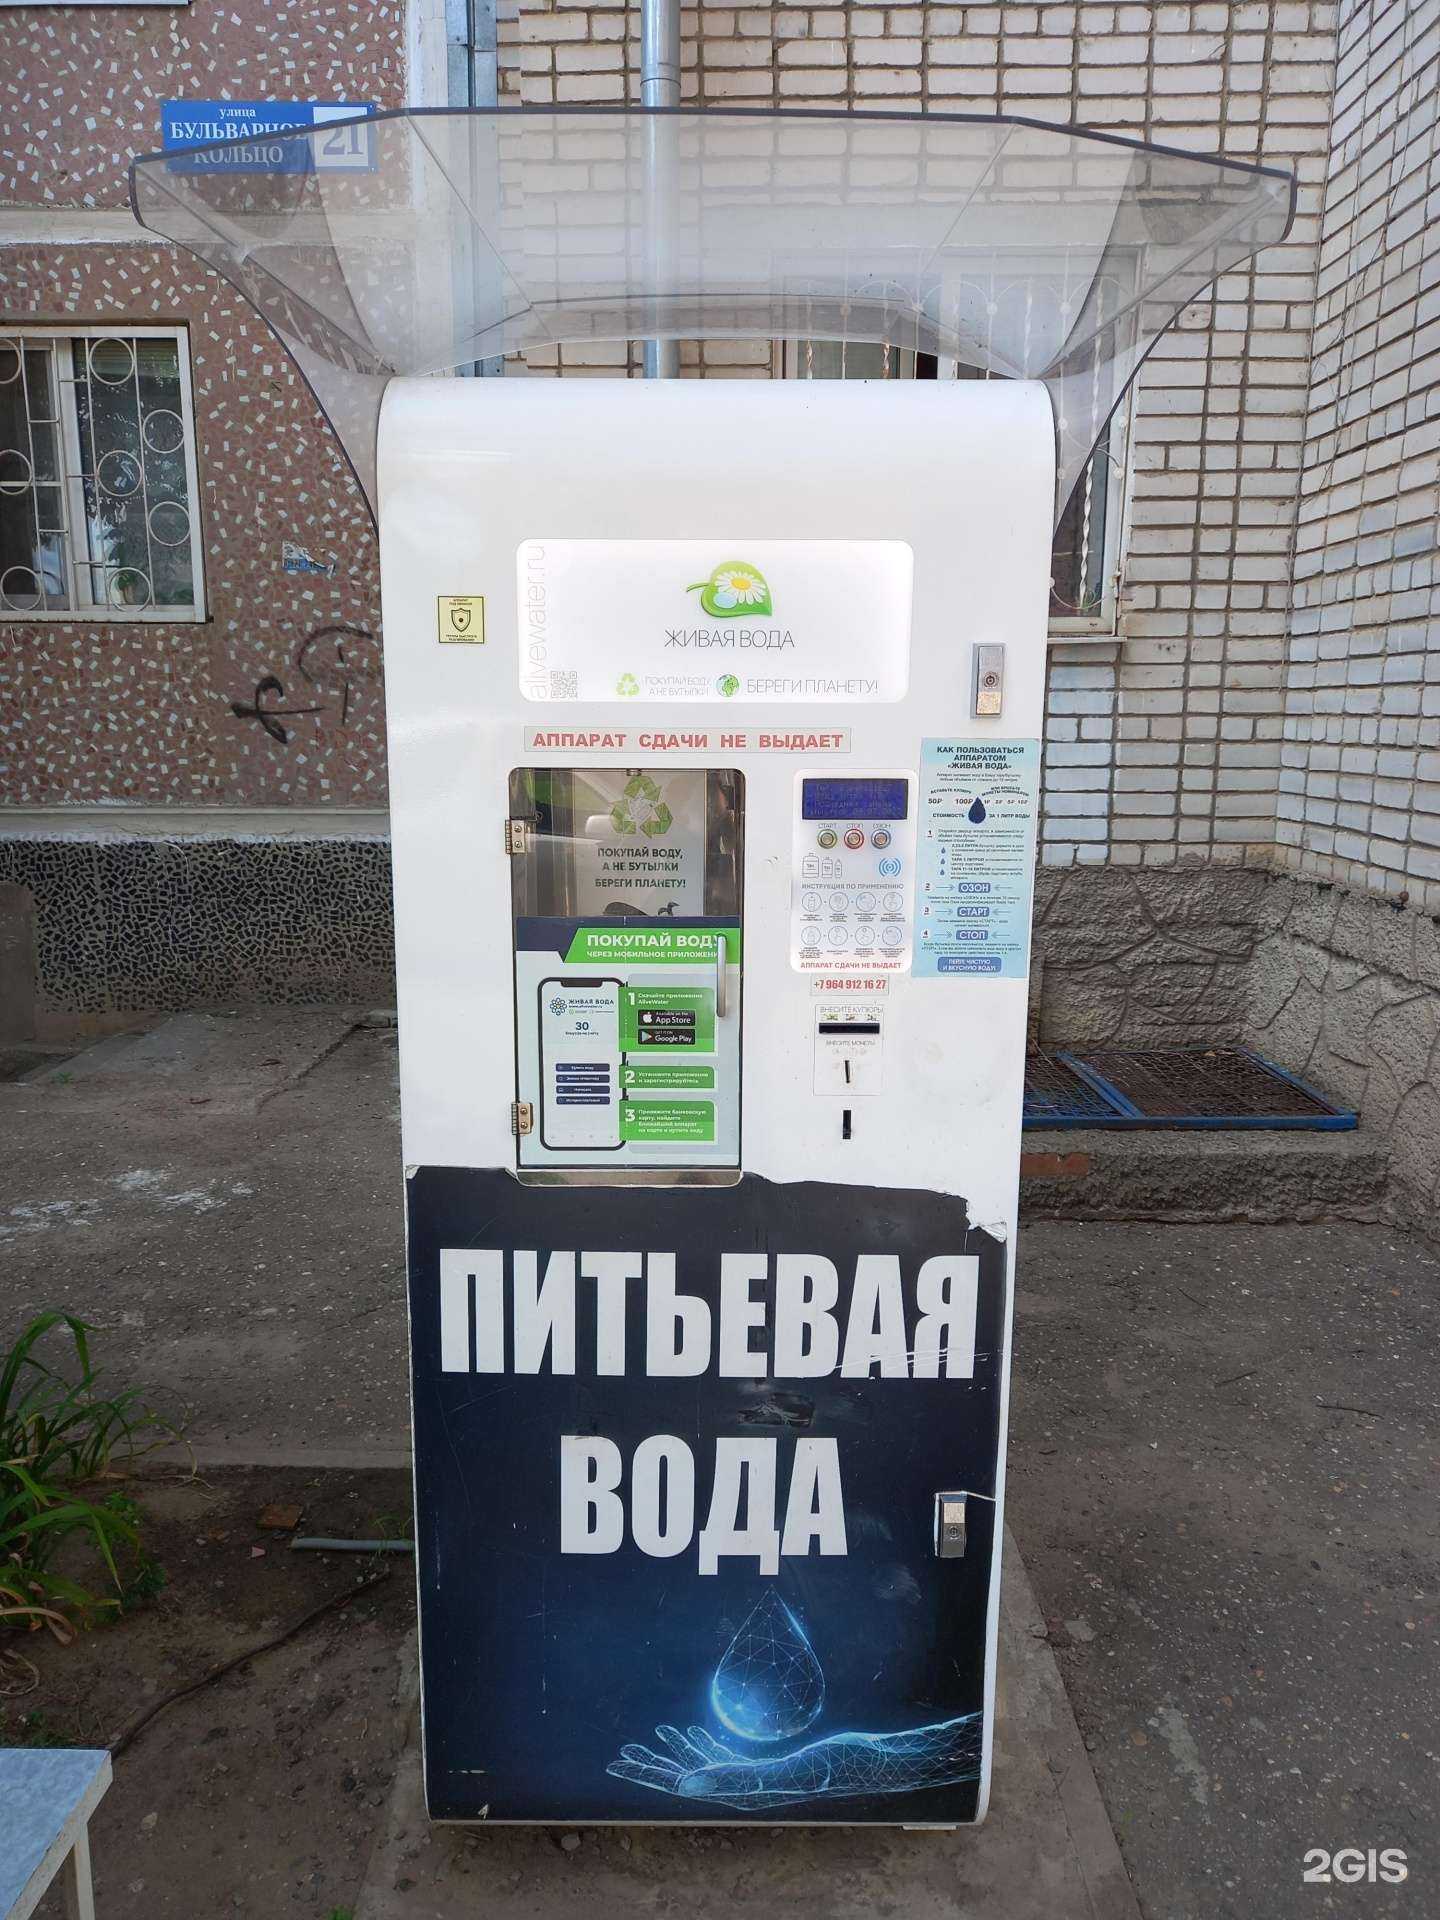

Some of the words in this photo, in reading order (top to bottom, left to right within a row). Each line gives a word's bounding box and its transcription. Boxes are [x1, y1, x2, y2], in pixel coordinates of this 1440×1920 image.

[219, 107, 257, 120] улица
[322, 125, 364, 156] 21
[193, 146, 284, 168] КОЛЬЦО
[526, 545, 547, 699] alivewater.ru
[664, 629, 735, 648] ЖИВАЯ
[739, 630, 795, 650] ВОДА
[747, 679, 802, 693] БЕРЕГИ
[805, 679, 879, 693] ПЛАНЕТУ!
[532, 733, 627, 748] АППАРАТ
[638, 734, 708, 750] СДАЧИ
[720, 734, 747, 748] НЕ
[759, 734, 844, 750] ВЫДАЕТ
[937, 746, 954, 754] КАК
[956, 746, 1025, 755] ПОЛЬЗОВАТЬСЯ
[954, 754, 1006, 762] АППАРАТОМ
[597, 846, 650, 858] ПОКУПАЙ
[652, 848, 684, 860] ВОДУ,
[602, 862, 610, 872] А
[612, 862, 626, 872] НЕ
[628, 862, 679, 873] БУТЫЛКИ
[595, 878, 632, 888] БЕРЕГИ
[635, 878, 686, 889] ПЛАНЕТУ!
[960, 884, 990, 892] ОЗОН
[959, 907, 988, 916] СТАРТ
[586, 931, 672, 947] ПОКУПАЙ
[959, 930, 986, 939] СТОП
[813, 979, 825, 990] +7
[825, 979, 843, 990] 964
[845, 980, 862, 990] 912
[863, 980, 874, 990] 16
[875, 980, 887, 990] 27
[628, 992, 635, 1006] 1
[575, 1021, 590, 1031] 30
[655, 1016, 671, 1025] App
[671, 1016, 691, 1024] Store
[655, 1034, 678, 1044] Google
[678, 1034, 692, 1044] Play
[624, 1070, 636, 1084] 2
[624, 1108, 636, 1122] 3
[439, 1248, 980, 1380] ПИТЬЕВАЯ
[559, 1434, 848, 1577] ВОДА
